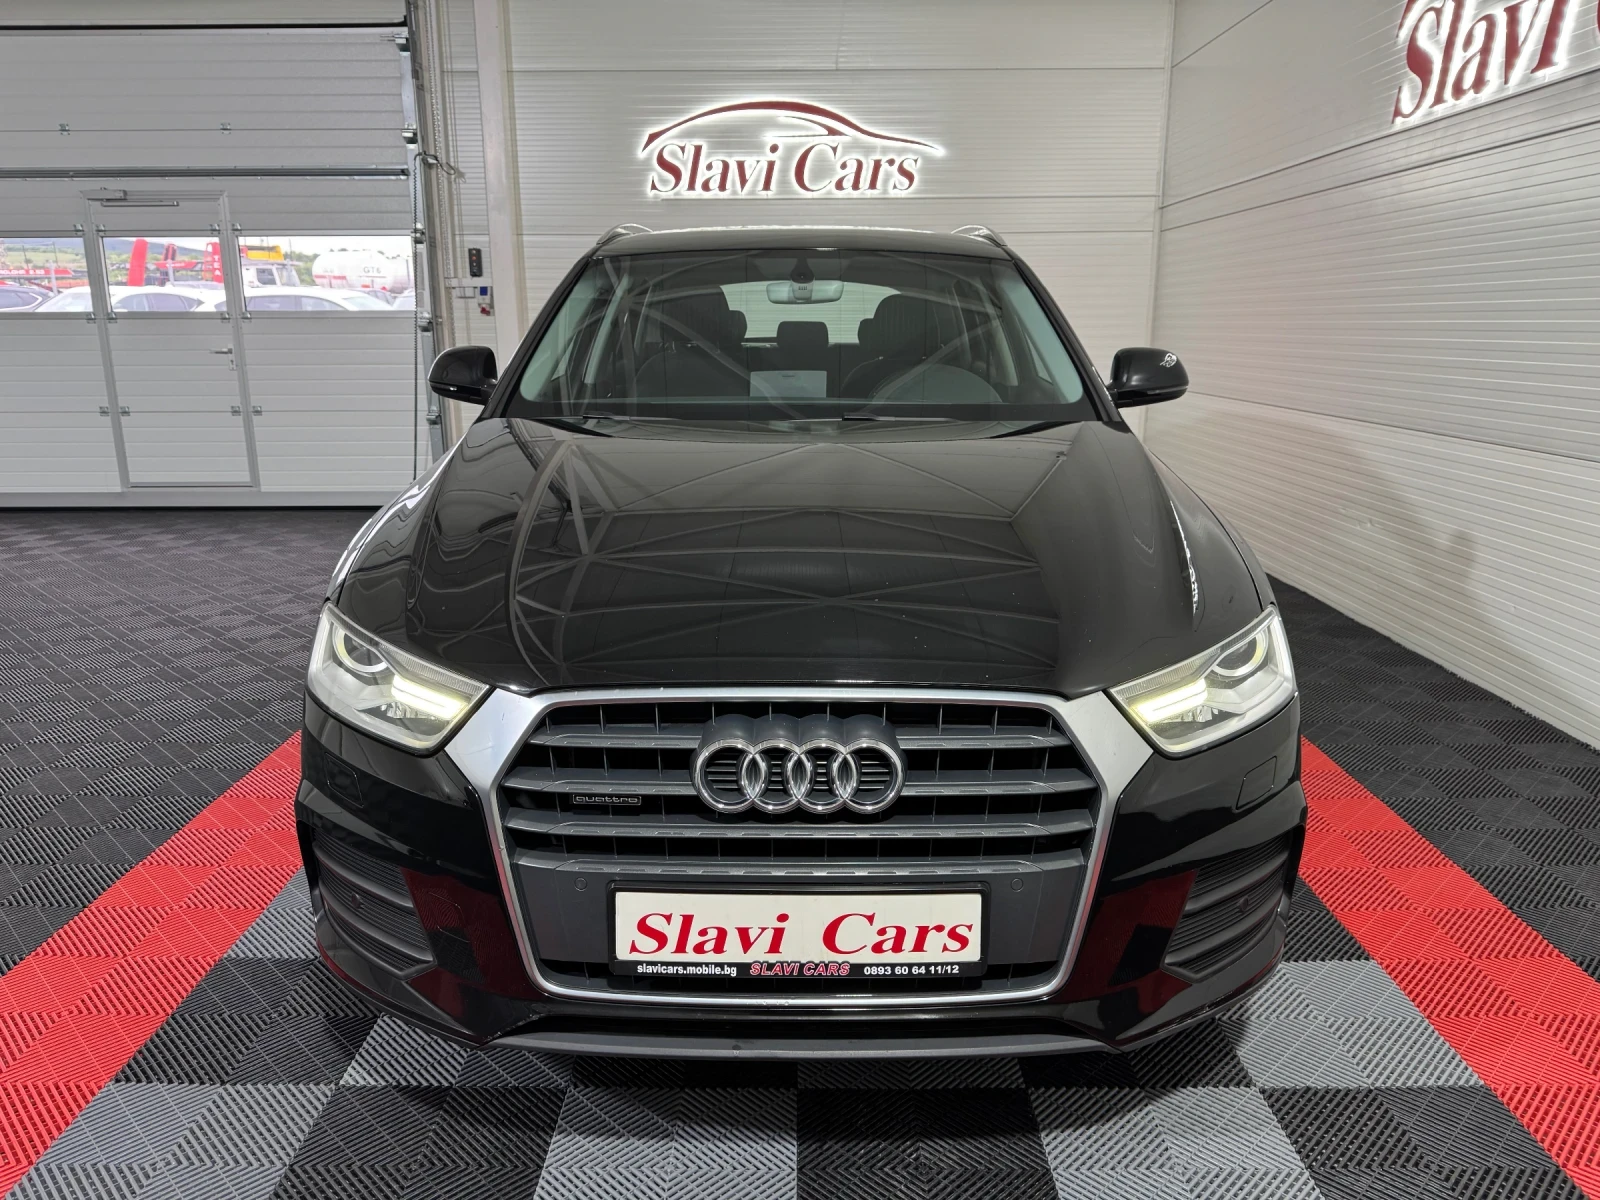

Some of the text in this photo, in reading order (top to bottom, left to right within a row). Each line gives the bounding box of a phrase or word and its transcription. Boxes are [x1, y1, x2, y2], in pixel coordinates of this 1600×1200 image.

[1391, 0, 1571, 124] Slavi
[649, 141, 920, 193] Slavi Cars
[629, 911, 974, 955] Slavi Cars
[636, 962, 960, 977] slavicars.mobile.bg SLAVI CARS 0893 60 64 11/12
